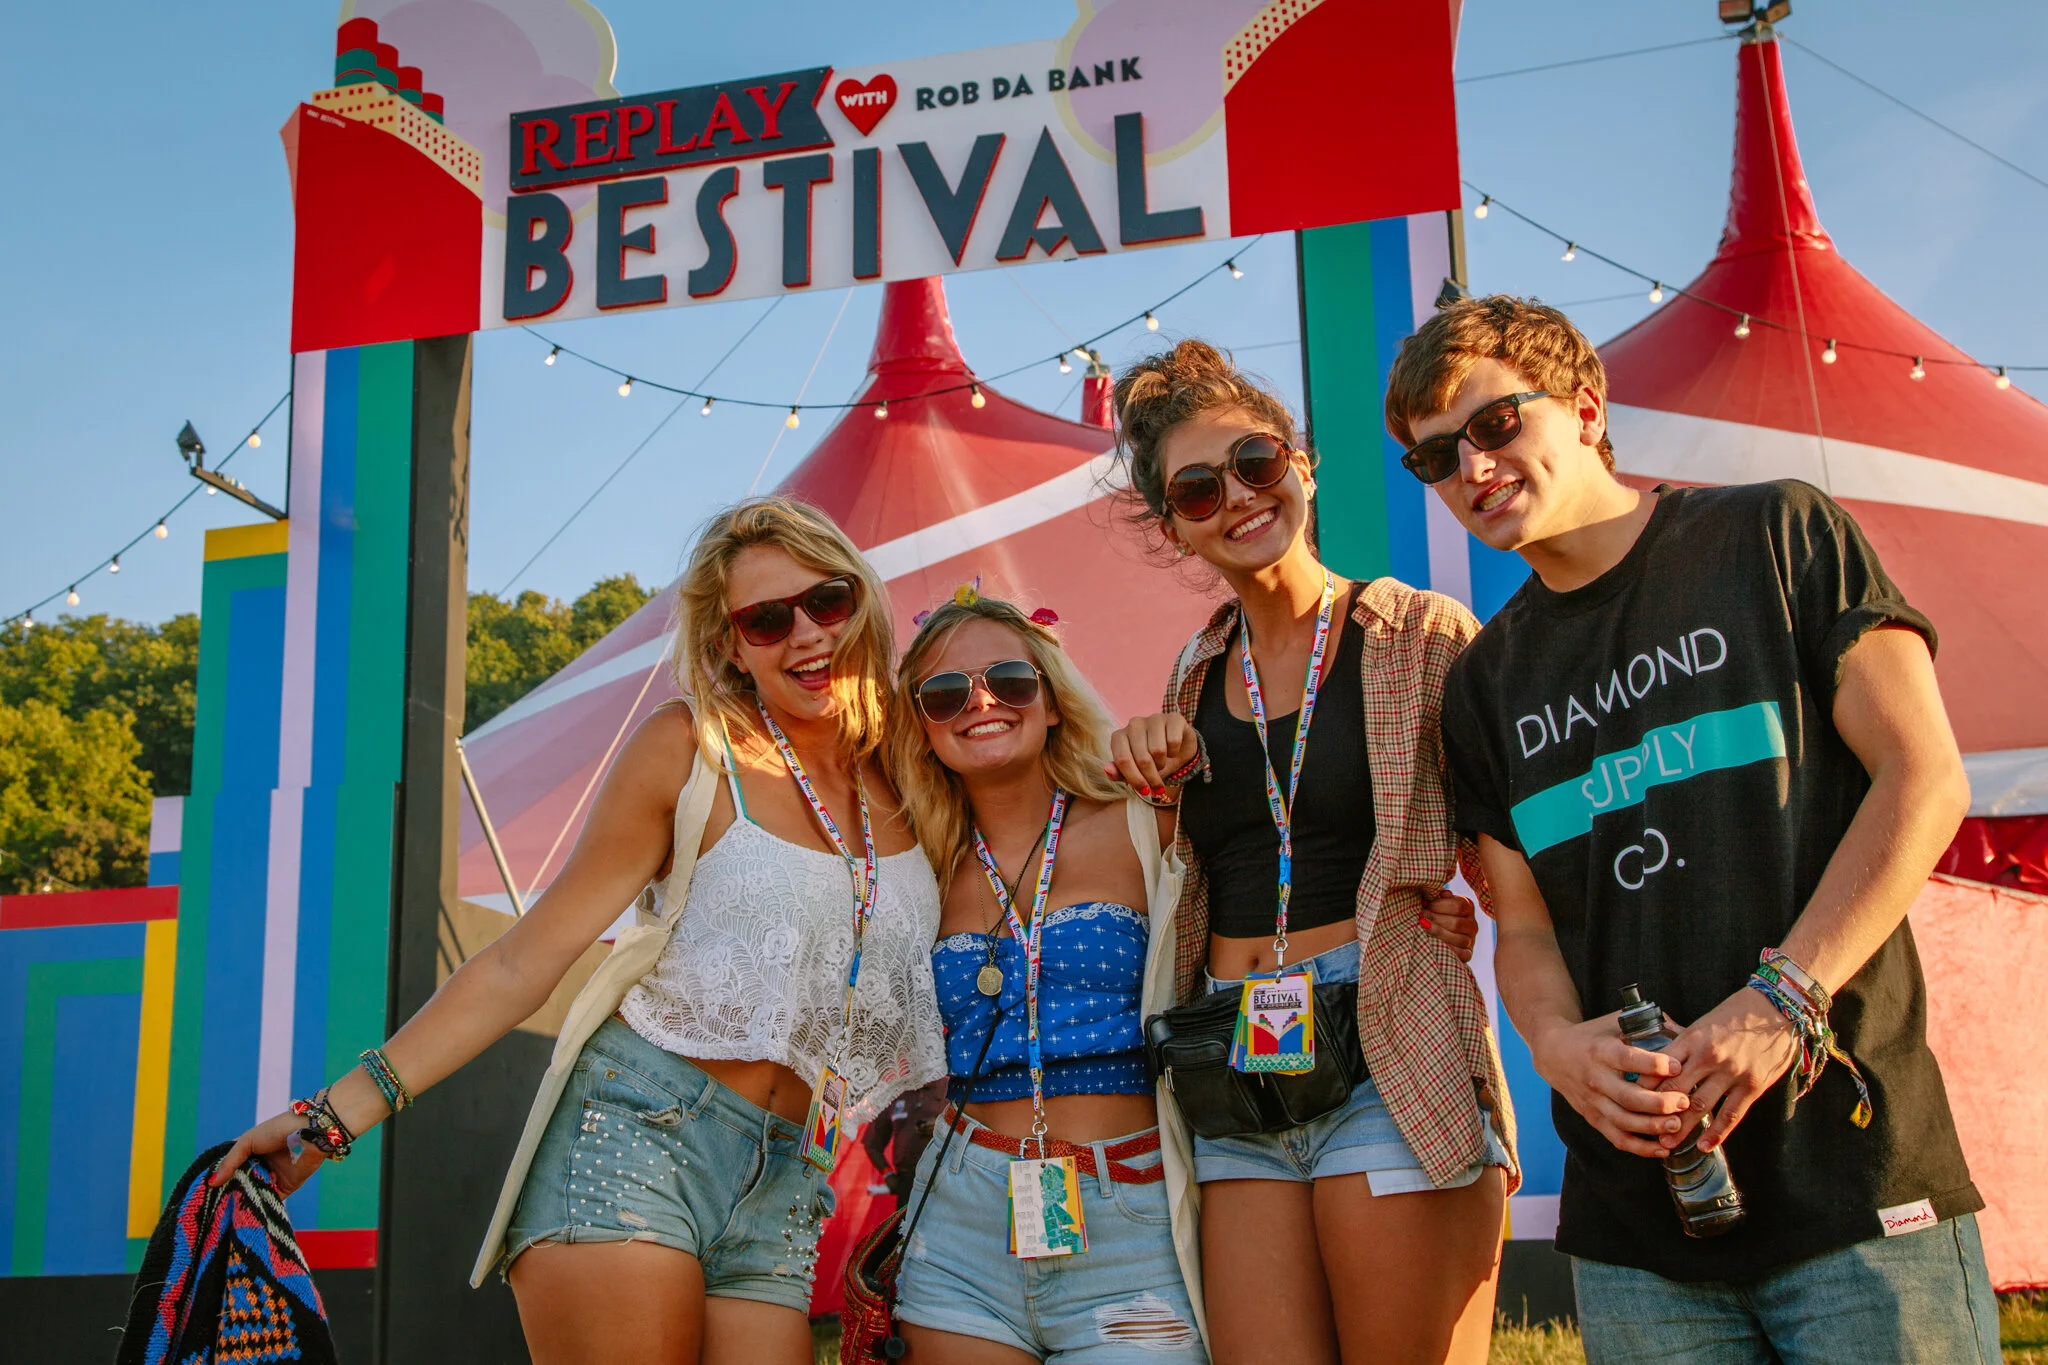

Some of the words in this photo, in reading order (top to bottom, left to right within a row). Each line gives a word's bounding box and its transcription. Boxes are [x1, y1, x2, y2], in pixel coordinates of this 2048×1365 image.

[841, 90, 888, 107] WITH
[916, 81, 980, 111] ROB
[993, 74, 1033, 101] DA
[1048, 57, 1144, 92] BANK
[518, 80, 800, 176] REPLAY
[502, 111, 1206, 322] BESTIVAL
[1516, 628, 1727, 760] DIAMOND
[1614, 828, 1685, 890] CO.
[1254, 993, 1300, 1004] BESTIVAL
[1884, 1207, 1932, 1229] Diamond
